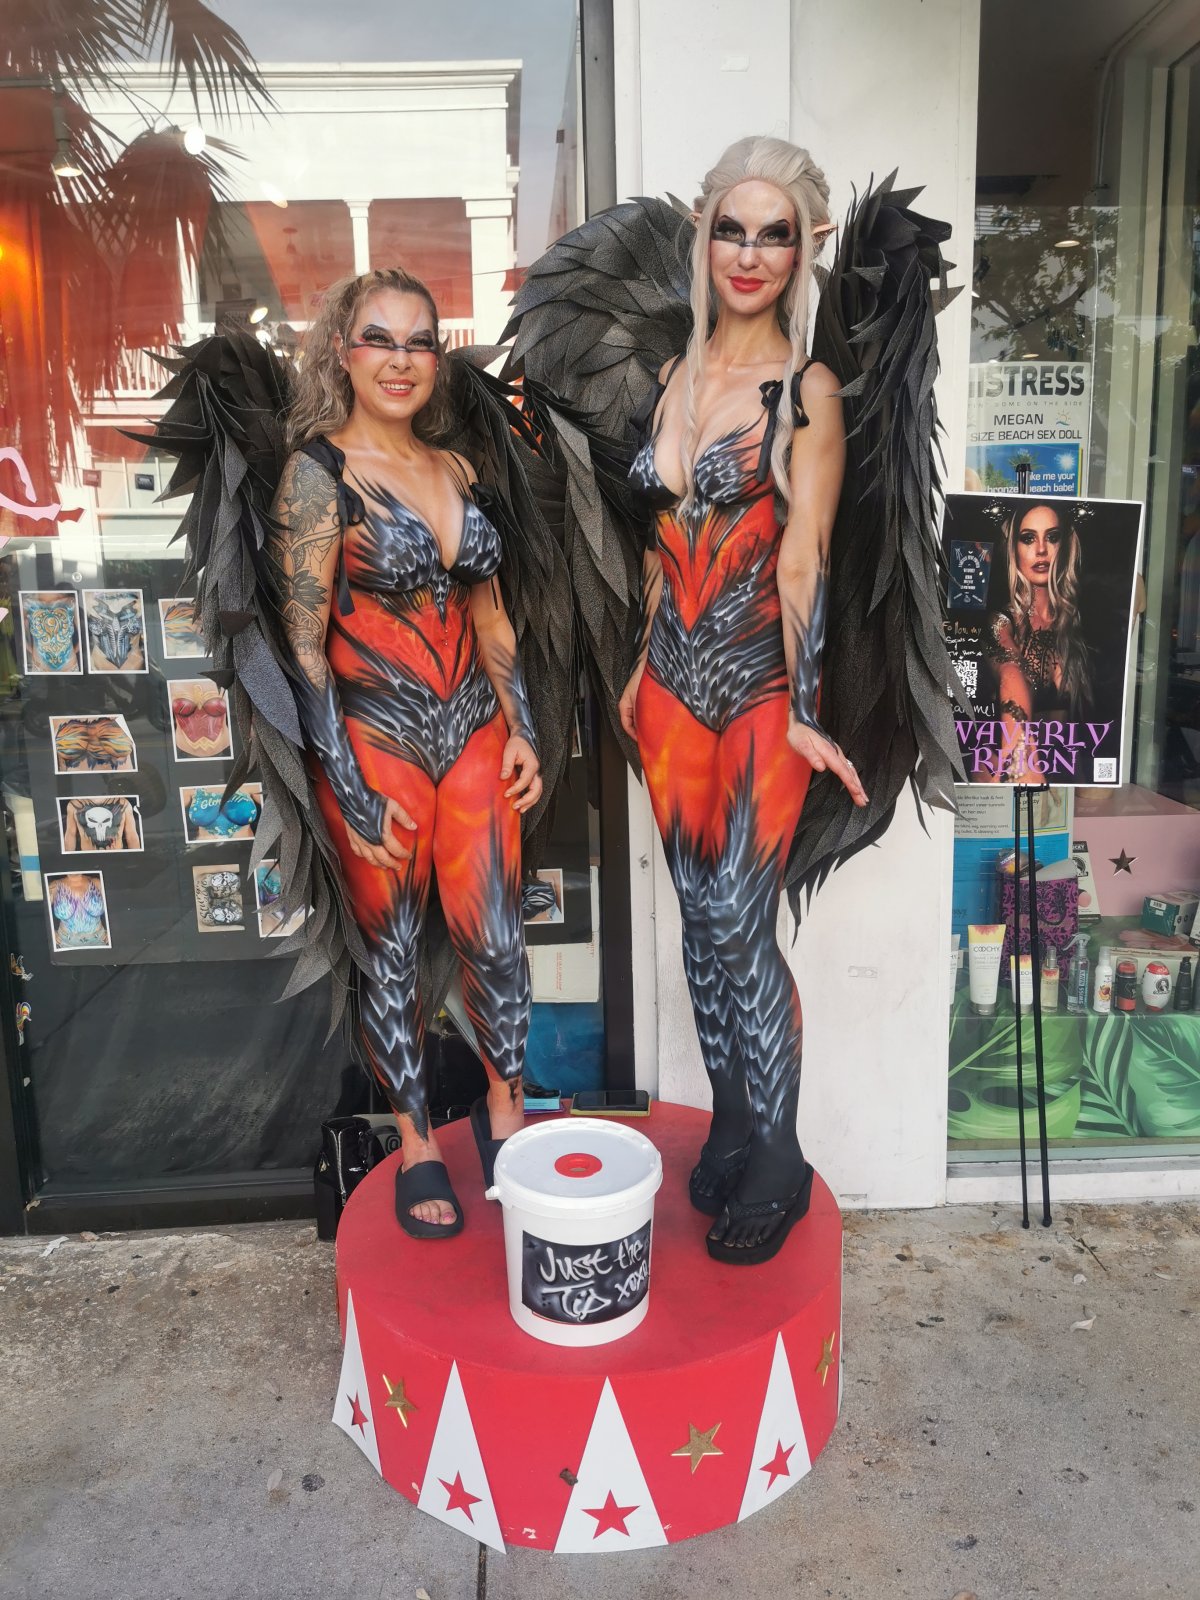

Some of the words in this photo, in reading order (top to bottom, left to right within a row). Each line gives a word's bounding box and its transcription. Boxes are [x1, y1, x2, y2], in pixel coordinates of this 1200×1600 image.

[993, 413, 1044, 426] MEGAN
[970, 431, 995, 442] SIZE
[998, 430, 1034, 441] BEACH
[1037, 430, 1056, 440] SEX
[1058, 429, 1082, 440] DOLL
[1043, 472, 1056, 481] me
[1057, 472, 1075, 483] your
[1053, 481, 1075, 492] babe!
[954, 719, 1115, 757] WAVERLY
[970, 748, 1081, 777] REIGN
[540, 1247, 613, 1282] Just
[613, 1239, 644, 1269] the
[541, 1281, 612, 1322] Tip
